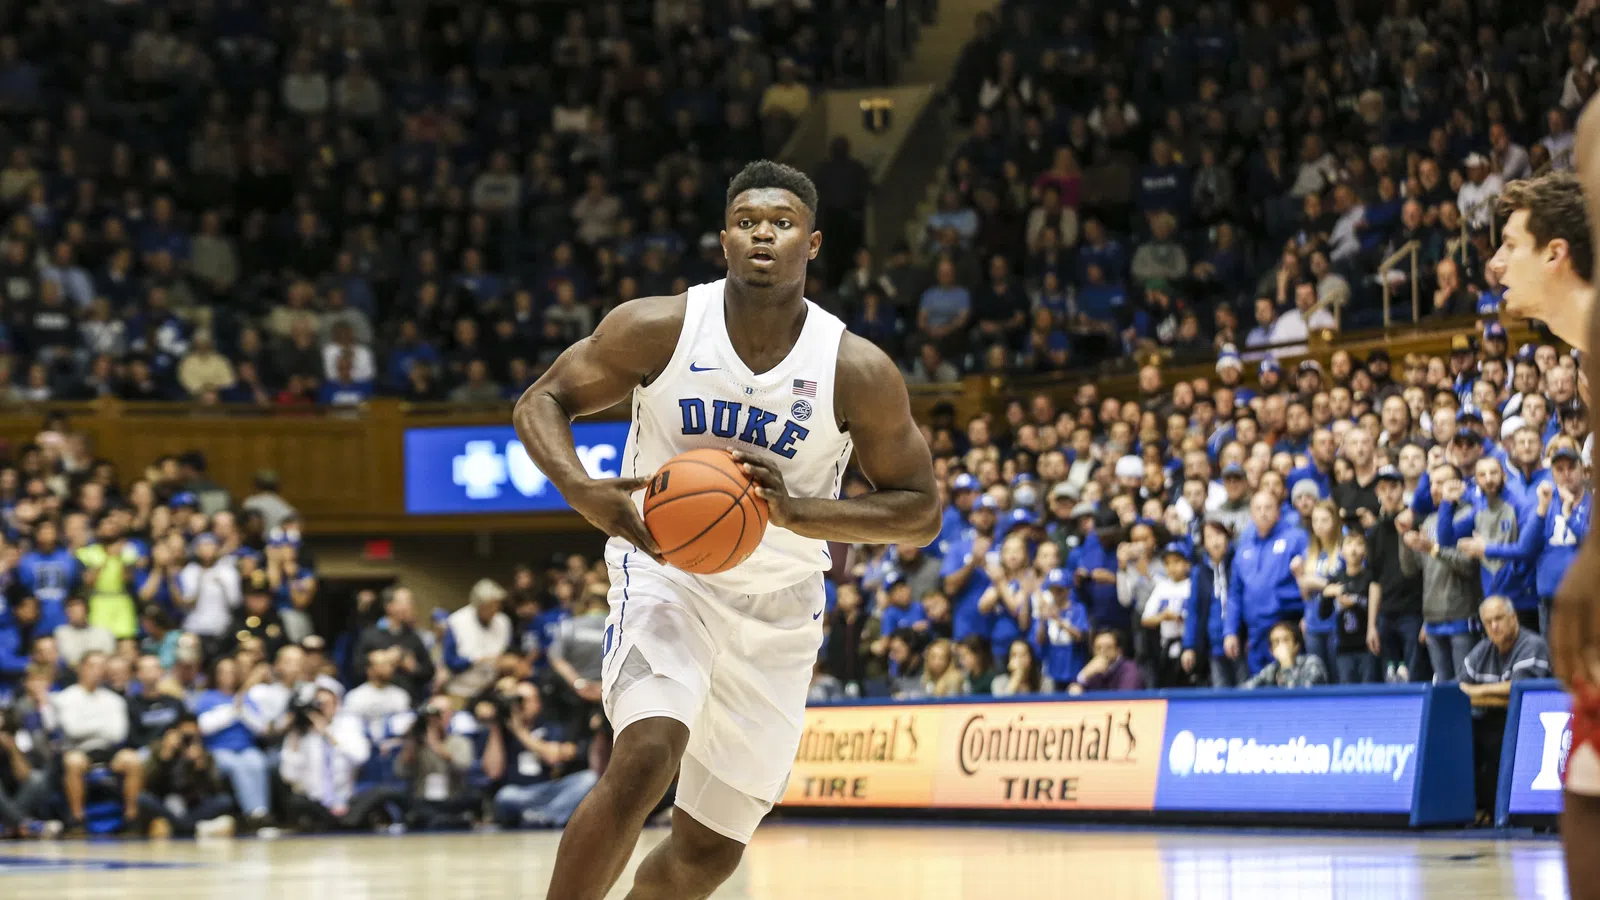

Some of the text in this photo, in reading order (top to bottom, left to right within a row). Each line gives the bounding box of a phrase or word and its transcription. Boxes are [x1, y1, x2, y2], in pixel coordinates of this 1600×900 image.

[678, 397, 810, 459] DUKE
[958, 714, 1113, 776] Continental
[1194, 735, 1410, 783] NC Education Lottery
[804, 777, 868, 798] TIRE
[1000, 777, 1080, 801] TIRE
